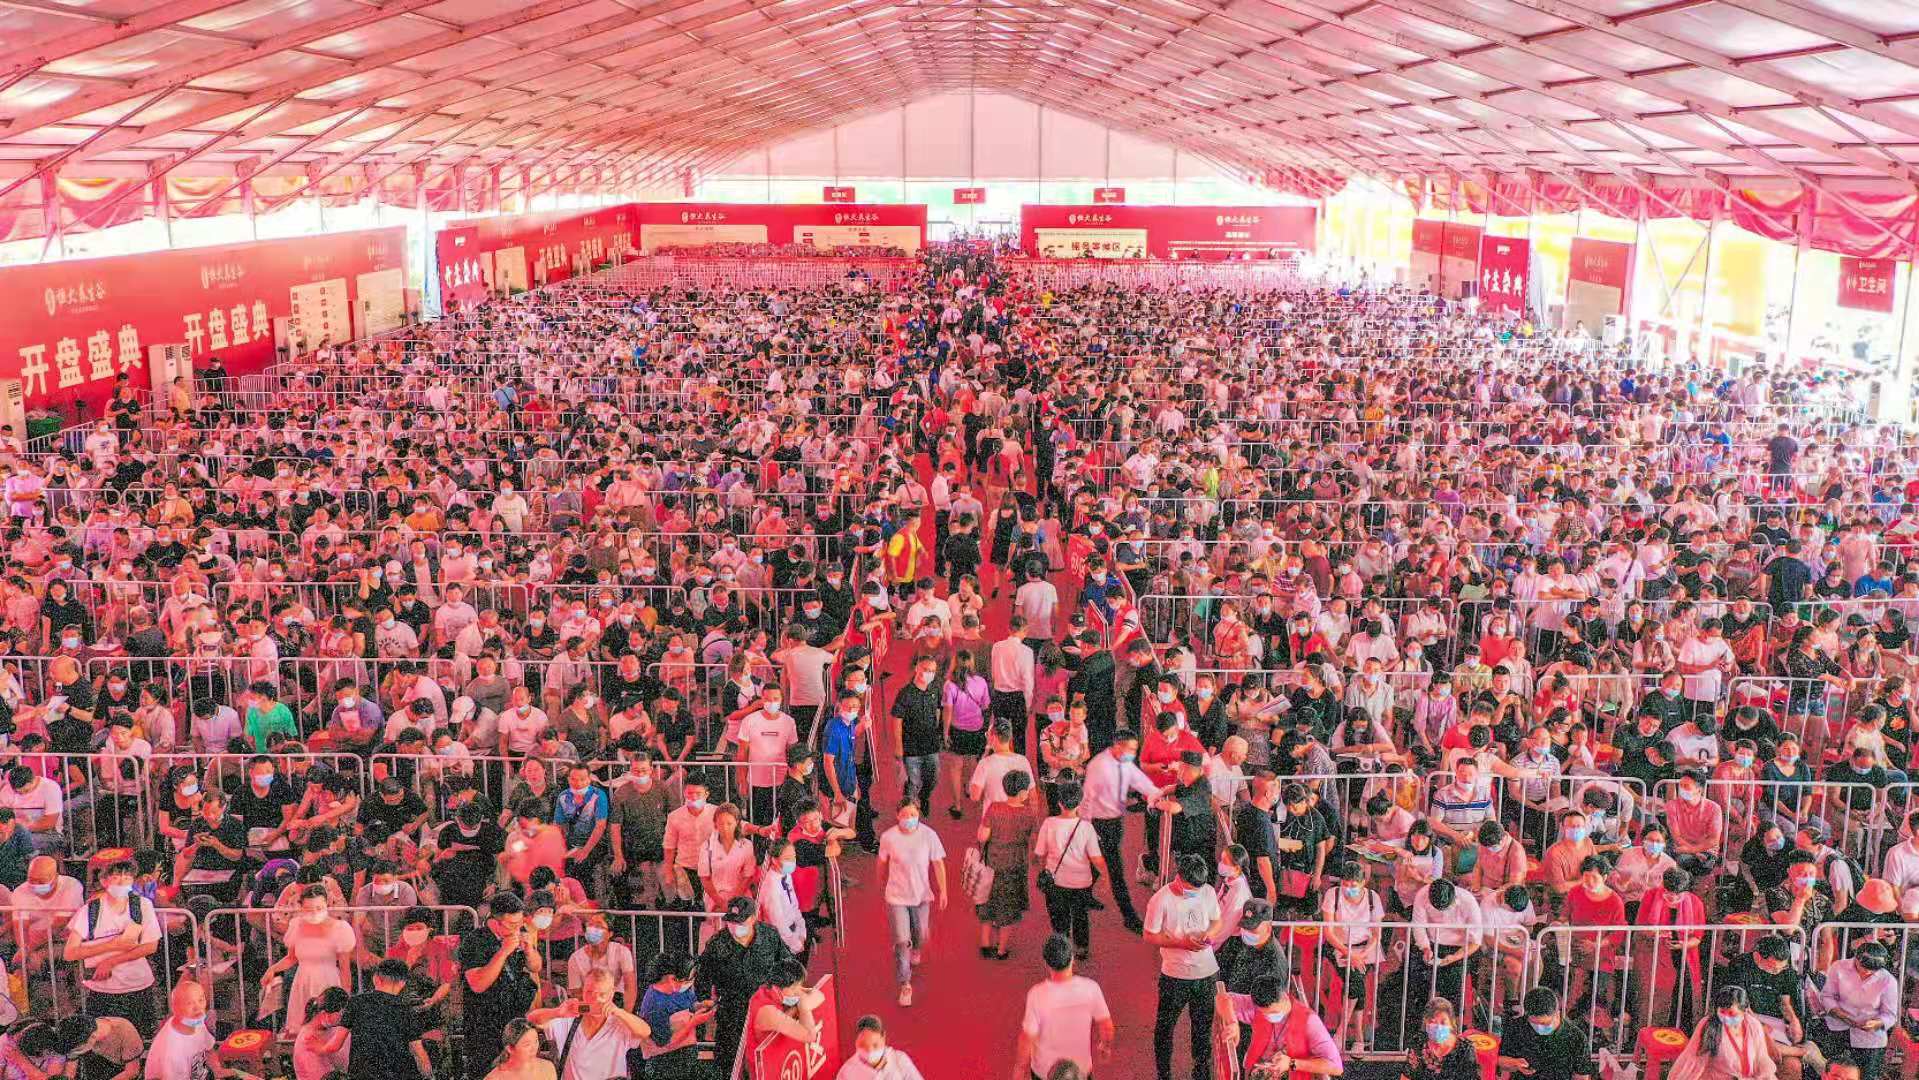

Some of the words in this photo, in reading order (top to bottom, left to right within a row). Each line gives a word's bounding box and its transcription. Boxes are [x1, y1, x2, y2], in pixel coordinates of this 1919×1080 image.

[1857, 276, 1887, 294] 卫生间
[182, 299, 271, 355] 开盘盛典
[19, 323, 143, 398] 开盘盛典
